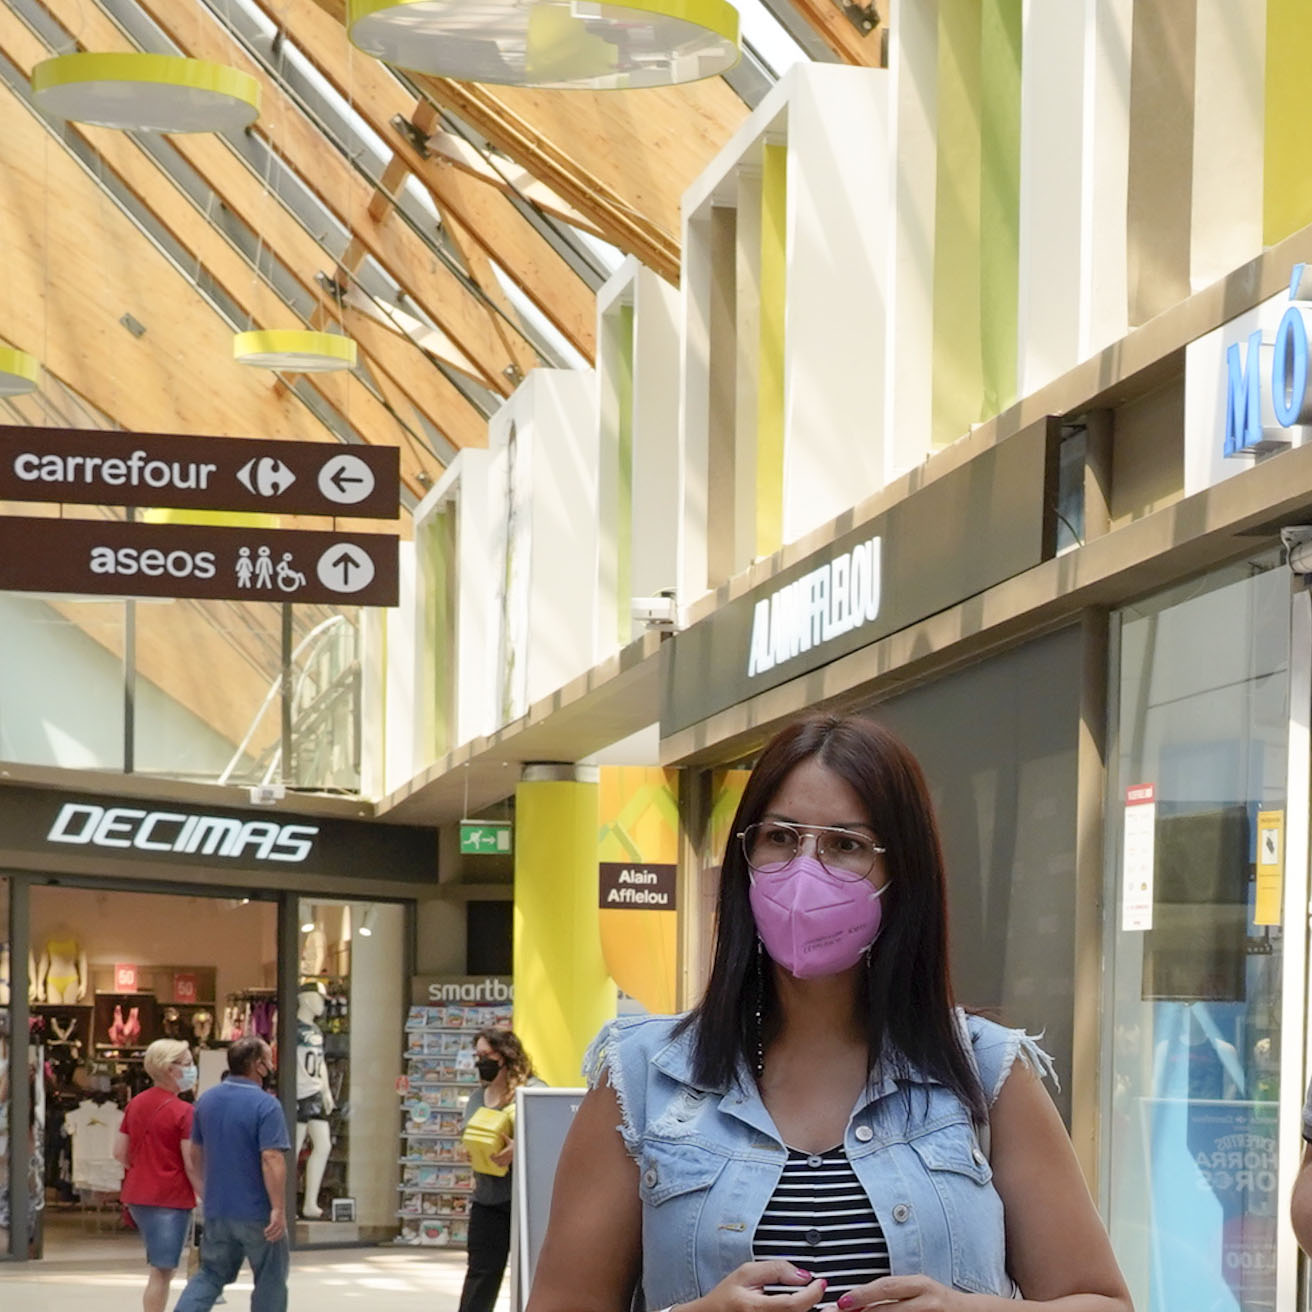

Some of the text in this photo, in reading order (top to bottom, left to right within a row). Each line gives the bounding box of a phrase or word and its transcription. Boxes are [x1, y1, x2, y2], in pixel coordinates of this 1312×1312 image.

[13, 450, 217, 490] carrefour
[88, 544, 217, 580] aseos
[46, 802, 319, 863] DECIMAS
[618, 868, 658, 886] Alain
[606, 887, 669, 906] Afflelou
[117, 970, 135, 986] 50
[177, 981, 194, 996] 50
